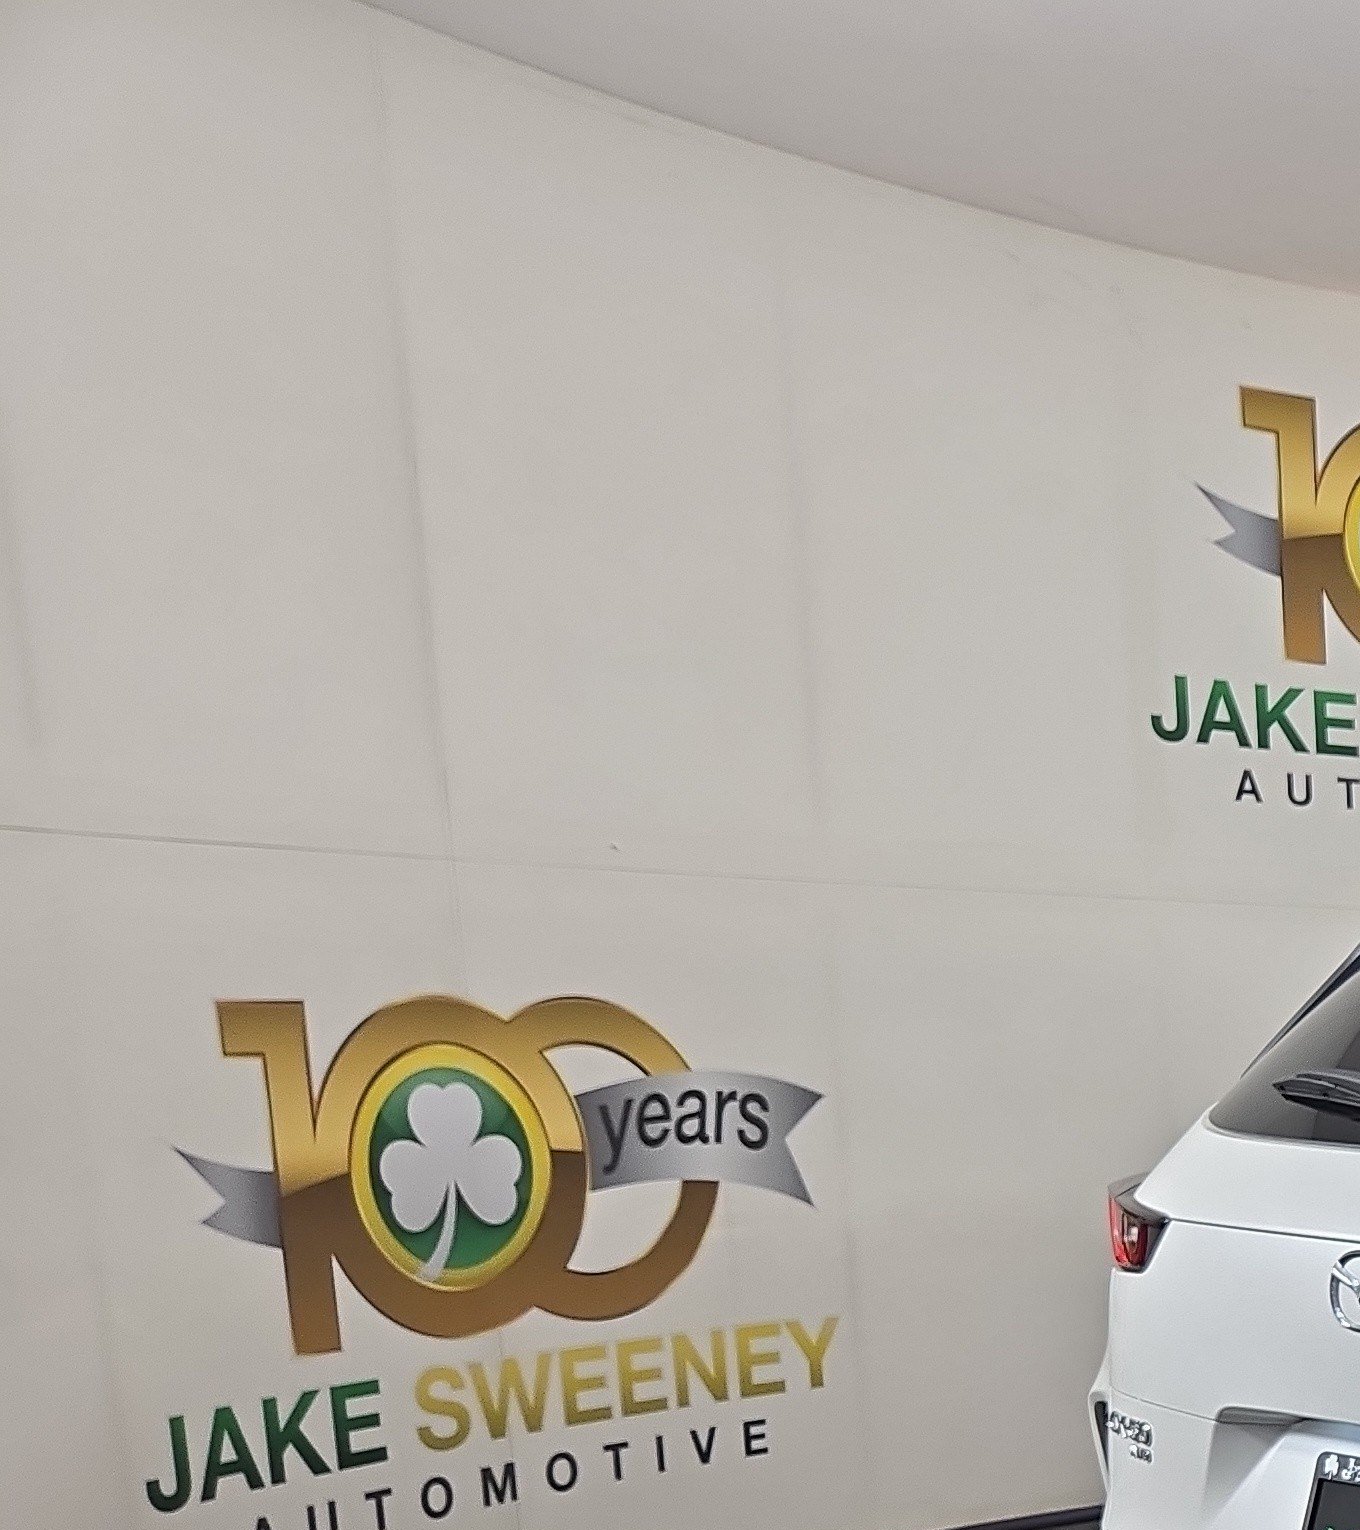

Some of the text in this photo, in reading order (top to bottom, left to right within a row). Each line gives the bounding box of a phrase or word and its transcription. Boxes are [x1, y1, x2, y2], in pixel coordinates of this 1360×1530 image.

[1151, 674, 1360, 758] JAKE
[215, 994, 771, 1356] 100 years
[145, 1316, 840, 1514] JAKE SWEENEY
